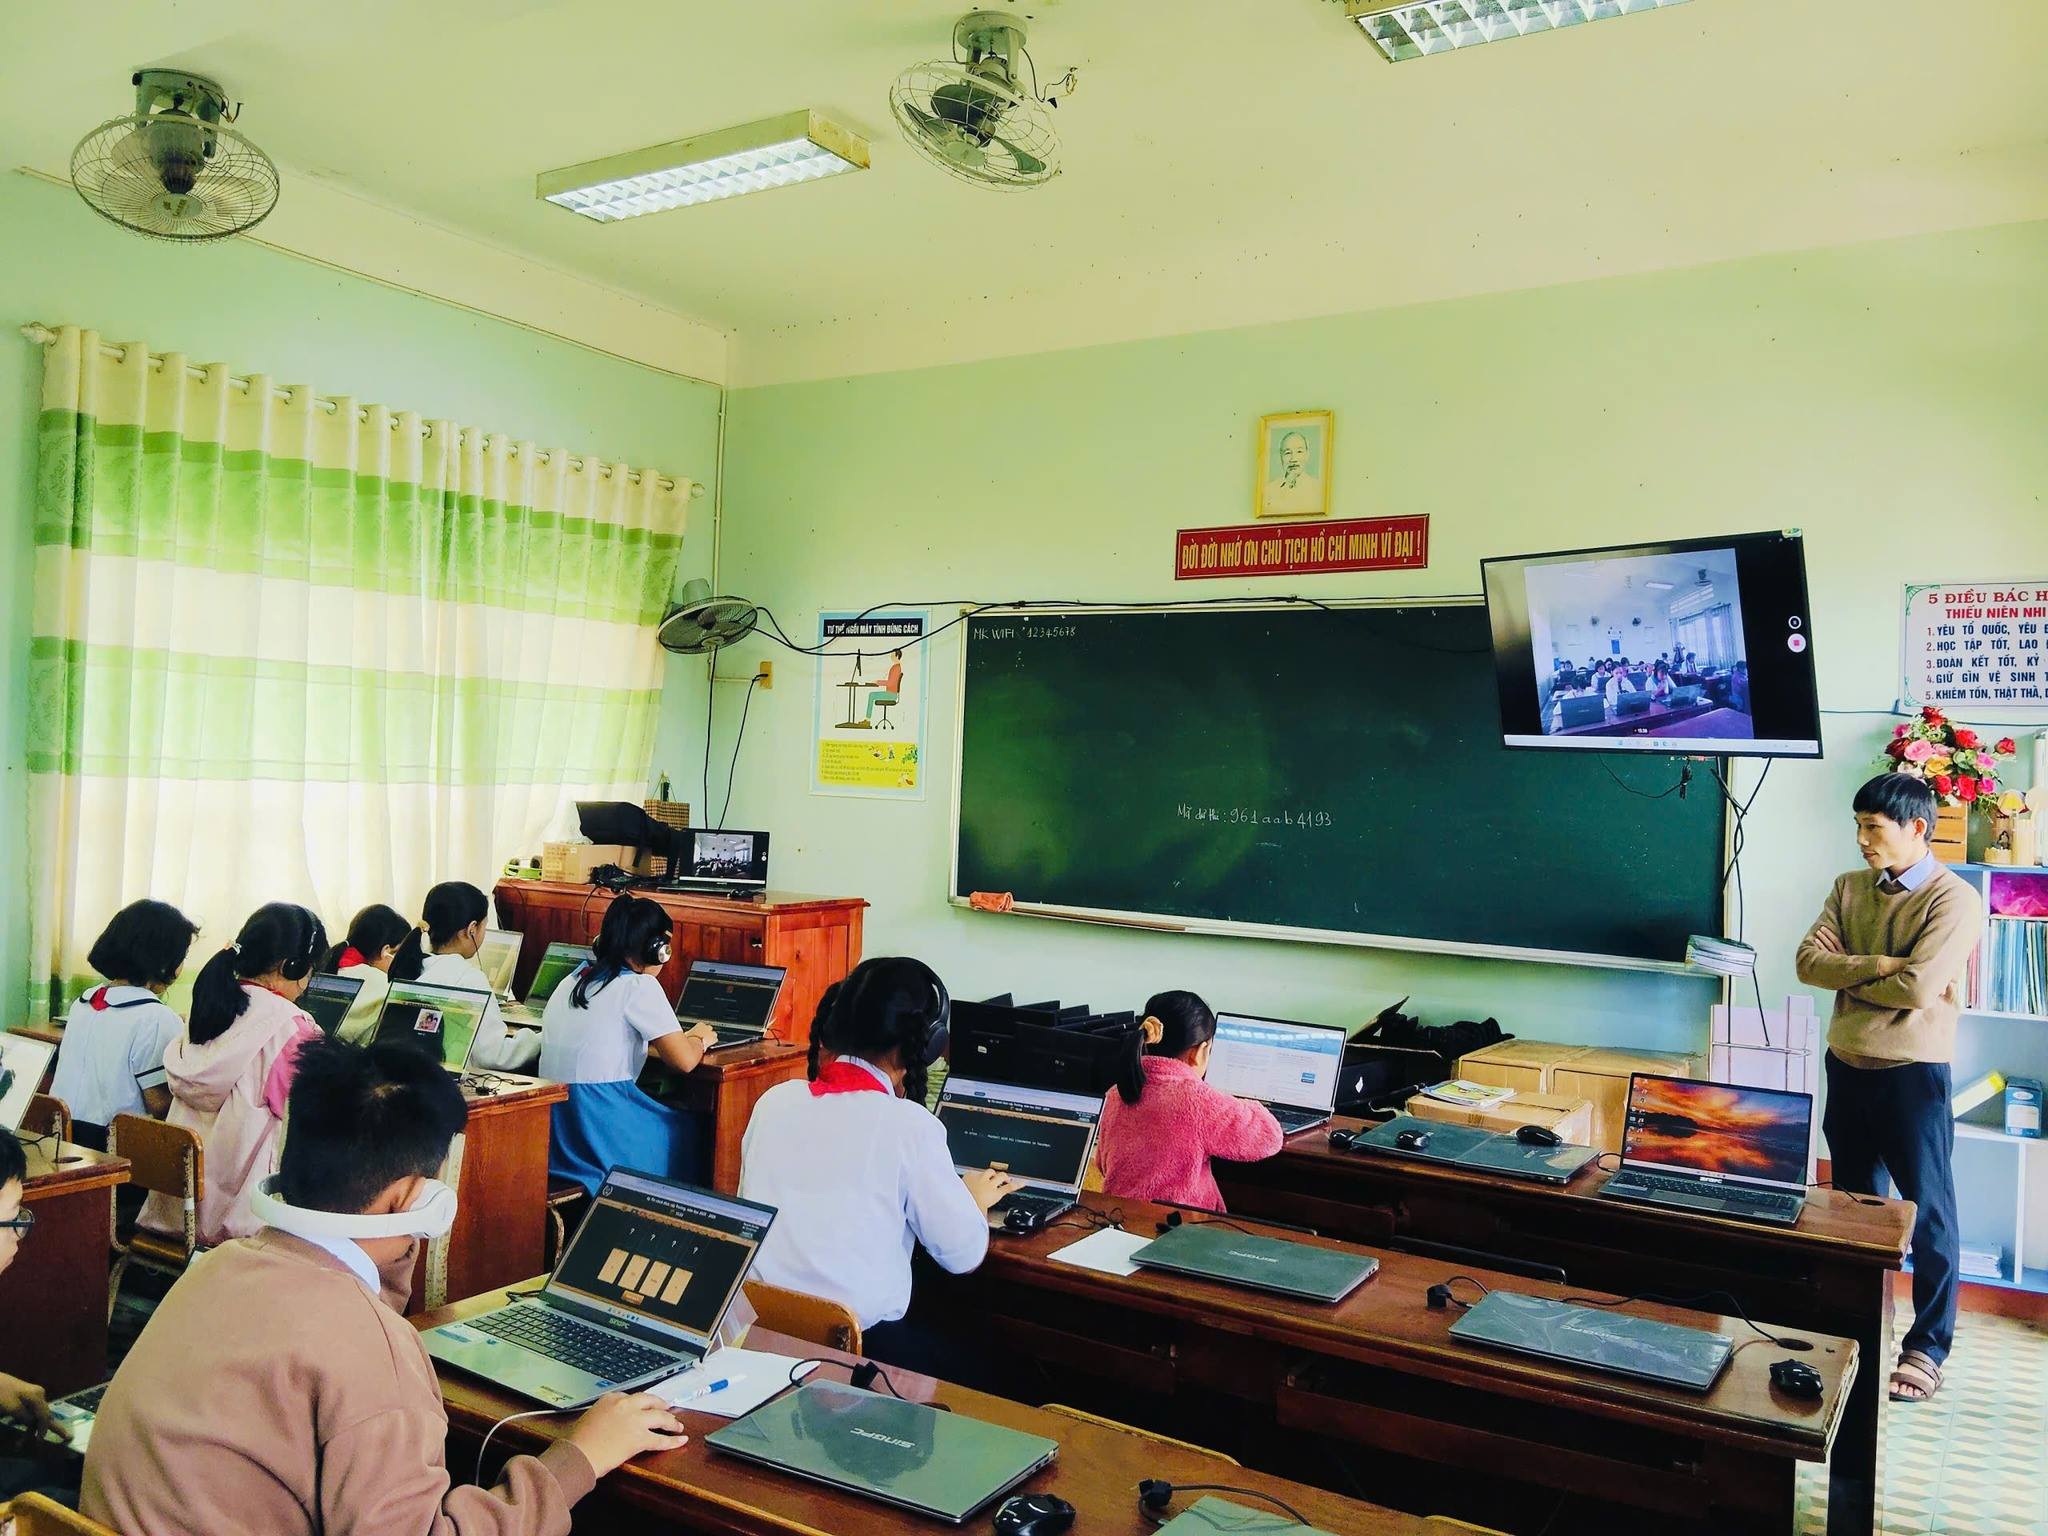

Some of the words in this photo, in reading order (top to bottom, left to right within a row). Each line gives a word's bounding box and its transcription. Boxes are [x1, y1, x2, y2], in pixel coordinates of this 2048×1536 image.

[1182, 538, 1199, 569] ĐỜI
[1200, 537, 1218, 568] ĐỜI
[1220, 534, 1242, 567] NHỚ
[1244, 539, 1259, 566] ƠN
[1261, 529, 1281, 565] CHỦ
[1285, 537, 1308, 569] TỊCH
[1311, 528, 1325, 562] HỒ
[1328, 530, 1346, 561] CHÍ
[1349, 533, 1378, 560] MINH
[1381, 527, 1393, 558] VĨ
[1394, 531, 1414, 563] ĐẠI
[1928, 593, 1938, 604] 5
[1944, 588, 1987, 603] ĐIỀU
[1993, 587, 2029, 602] BÁC
[2035, 590, 2048, 602] H
[1945, 605, 1982, 619] THIẾU
[1986, 606, 2019, 618] NIÊN
[2023, 607, 2046, 618] NHI
[903, 622, 919, 634] CÁCH
[1937, 624, 1955, 636] YÊU
[1982, 621, 2010, 635] QUỐC,
[2018, 622, 2037, 634] YÊU
[1937, 641, 1956, 653] HỌC
[1964, 638, 1982, 652] TẬP
[1991, 637, 2010, 650] TỐT,
[2019, 639, 2038, 649] LAO
[1936, 656, 1963, 668] ĐOÀN
[1971, 655, 1989, 667] KẾT
[1998, 654, 2017, 667] TỐT,
[1936, 671, 1954, 683] GIỮ
[1962, 670, 1979, 682] GÌN
[1989, 670, 2001, 684] VỆ
[2010, 672, 2035, 682] SINH
[1936, 687, 1966, 699] KHIÊM
[1969, 686, 1991, 699] TỐN,
[1994, 686, 2017, 700] THẬT
[2021, 685, 2042, 699] THÀ,
